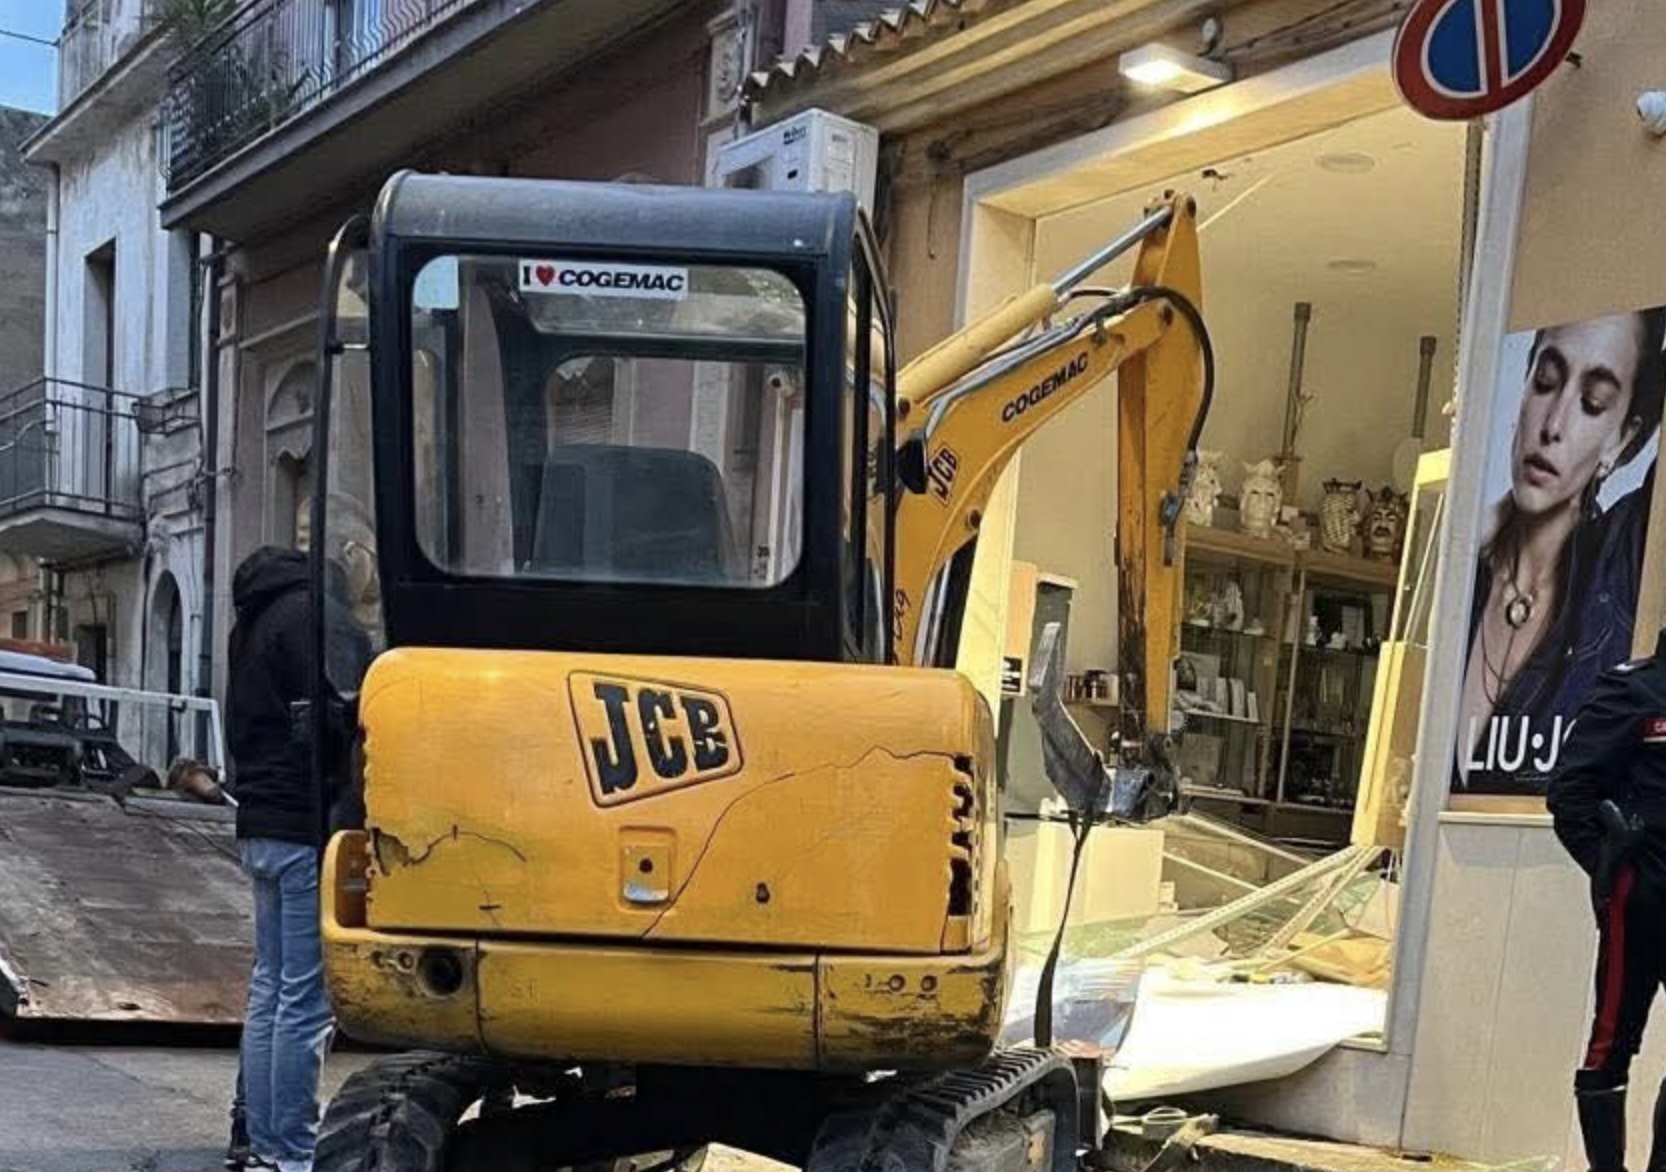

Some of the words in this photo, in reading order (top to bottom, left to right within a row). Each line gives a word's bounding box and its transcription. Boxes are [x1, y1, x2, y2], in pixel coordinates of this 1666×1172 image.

[523, 265, 531, 285] I
[559, 269, 684, 291] COGEMAC
[1002, 352, 1088, 422] COGEMAC
[928, 448, 957, 500] JCB
[590, 682, 729, 795] JCB
[1466, 715, 1577, 772] LIU·J
